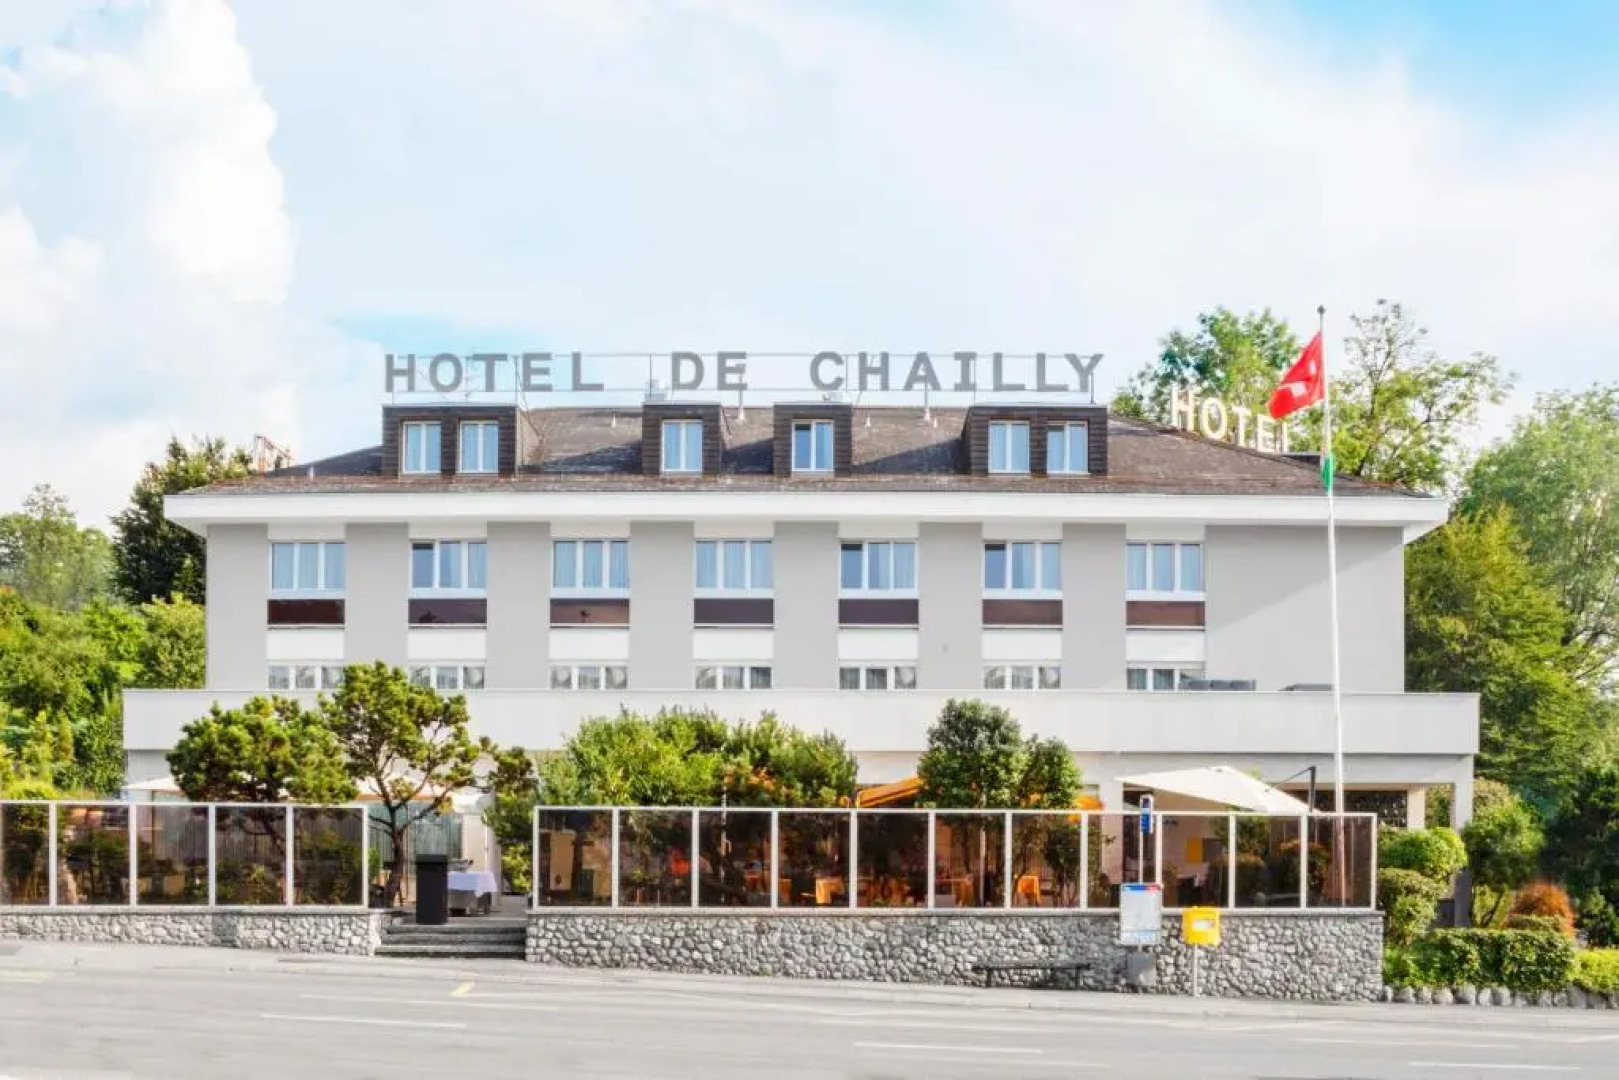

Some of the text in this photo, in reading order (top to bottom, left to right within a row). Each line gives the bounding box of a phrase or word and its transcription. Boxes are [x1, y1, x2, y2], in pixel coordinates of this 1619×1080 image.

[384, 351, 1105, 393] HOTEL DE CHAILLY
